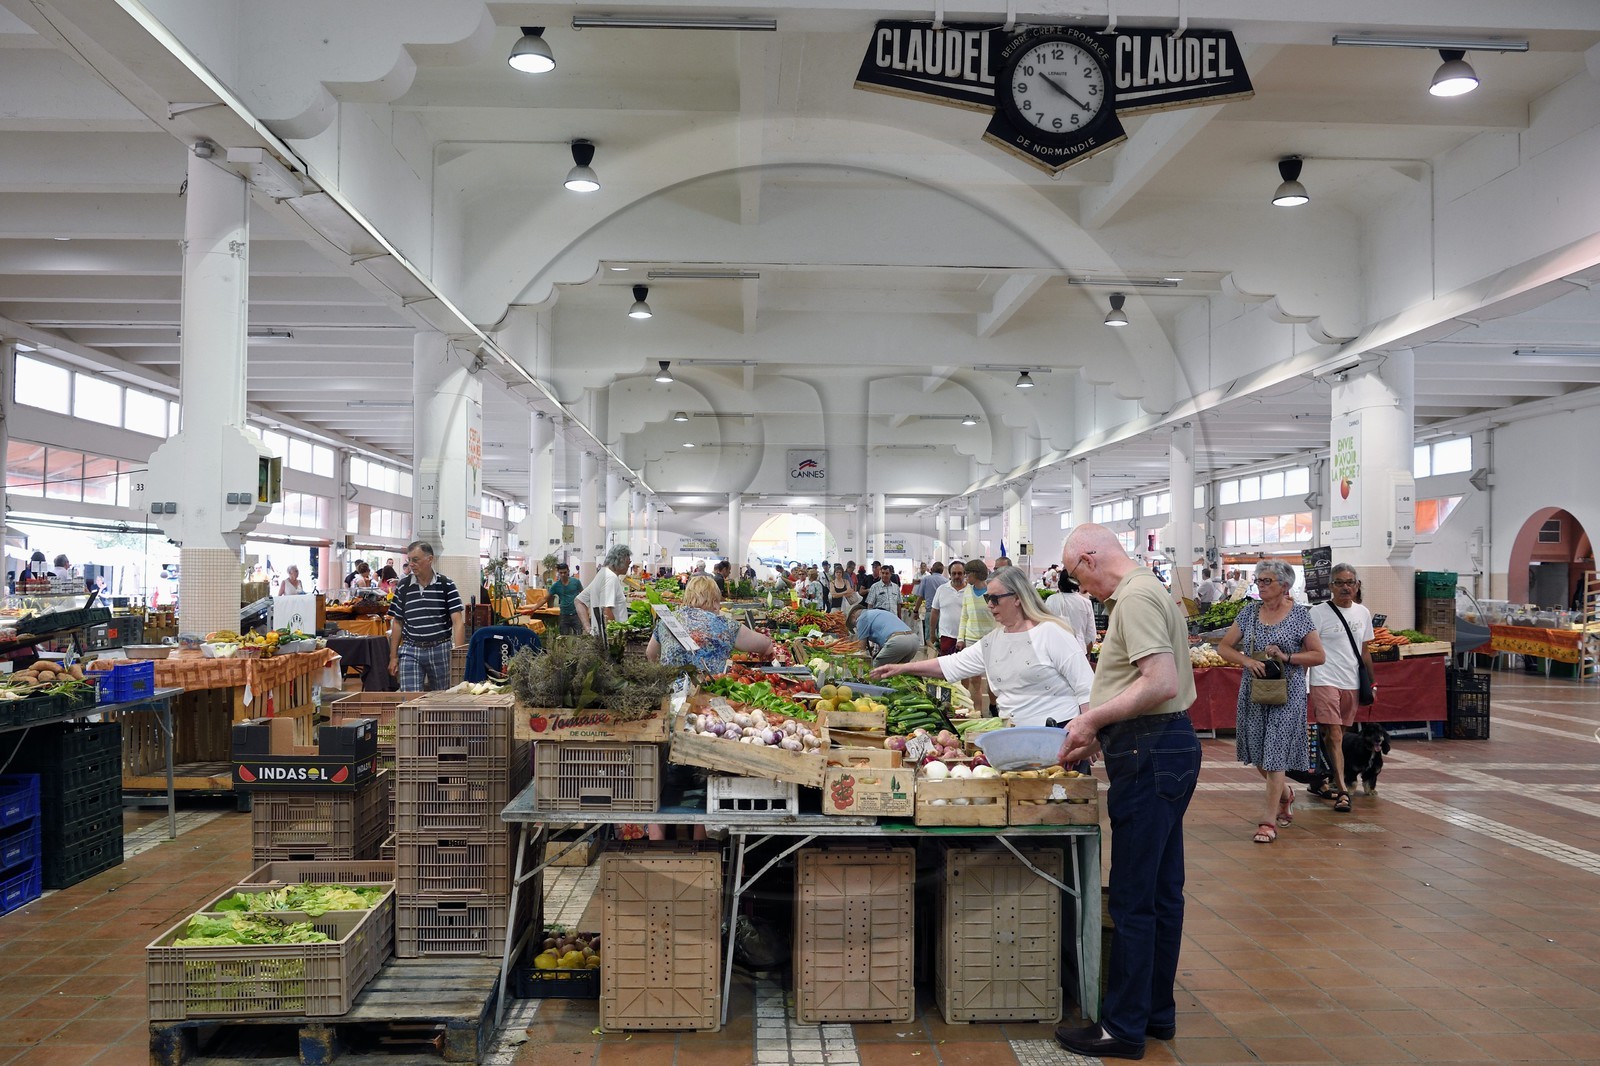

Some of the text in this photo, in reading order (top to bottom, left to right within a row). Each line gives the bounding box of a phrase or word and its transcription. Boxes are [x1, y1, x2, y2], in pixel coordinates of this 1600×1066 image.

[1001, 33, 1029, 58] BEURRE
[1067, 28, 1110, 61] FROMAGE
[876, 28, 995, 84] CLAUDEL
[1036, 53, 1046, 64] 11
[1051, 49, 1064, 60] 12
[1073, 54, 1078, 65] 1
[1115, 35, 1234, 88] CLAUDEL
[1023, 66, 1034, 76] 10
[1083, 67, 1092, 78] 2
[1017, 83, 1028, 93] 9
[1088, 84, 1097, 95] 3
[1023, 100, 1032, 110] 8
[1083, 101, 1092, 112] 4
[1036, 113, 1044, 124] 7
[1052, 118, 1062, 129] 6
[1070, 114, 1079, 124] 5
[1016, 135, 1096, 156] DE NORMANDIE
[1337, 436, 1354, 452] ENVIE
[1334, 450, 1357, 468] D'AVOIR
[790, 469, 825, 479] CANNES
[1331, 469, 1339, 482] LA
[136, 483, 144, 491] 33
